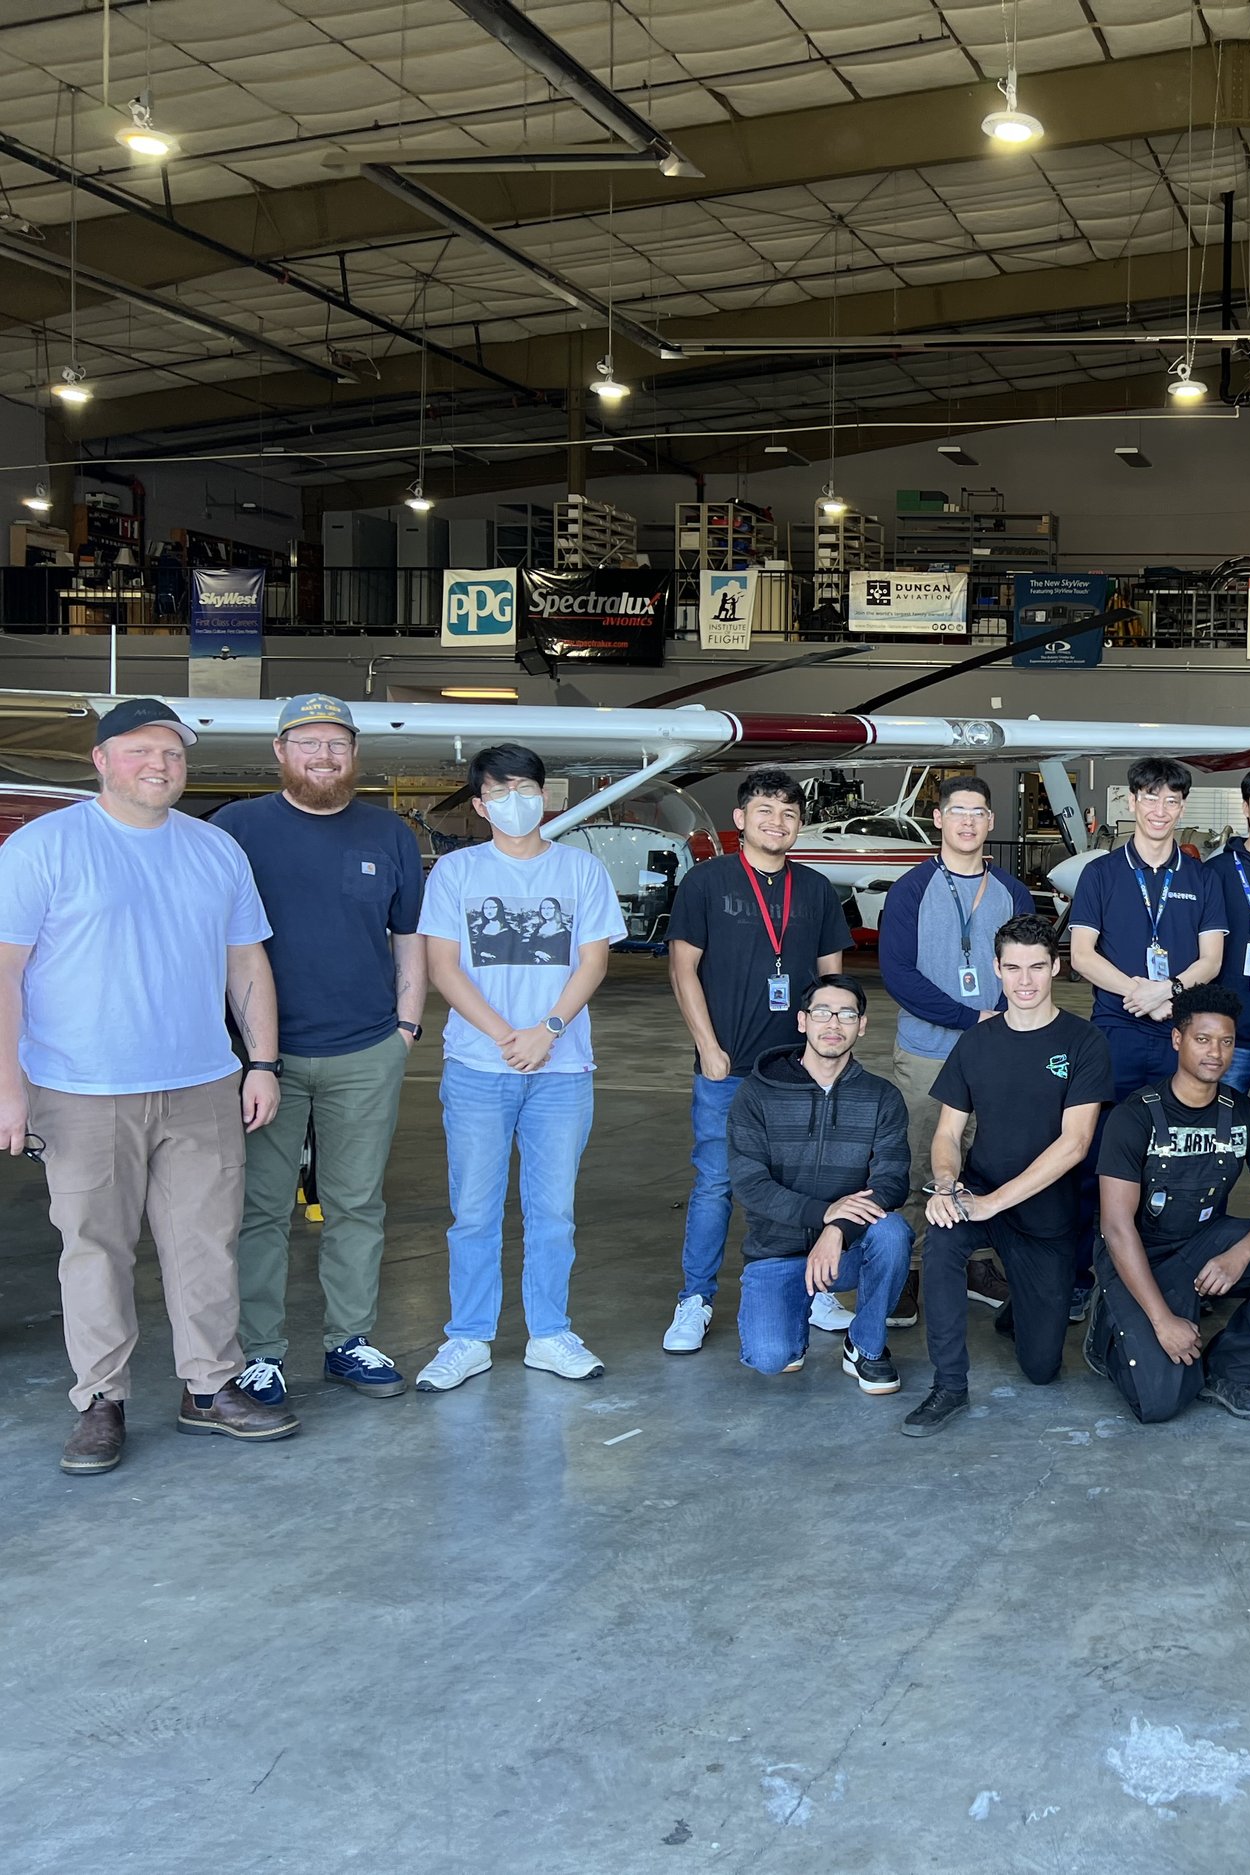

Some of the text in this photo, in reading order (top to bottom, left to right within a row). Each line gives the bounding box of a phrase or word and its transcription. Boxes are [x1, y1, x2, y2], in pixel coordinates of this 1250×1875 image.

[895, 583, 950, 592] DUNCAN
[1061, 579, 1089, 588] SkyView
[198, 592, 257, 608] SkyWest
[529, 588, 662, 617] Spectralux
[450, 585, 512, 631] PPG
[211, 618, 230, 627] Class
[231, 618, 258, 627] Careers
[602, 616, 653, 626] avionics
[708, 634, 746, 644] FLIGHT
[1183, 1132, 1218, 1153] ARM
